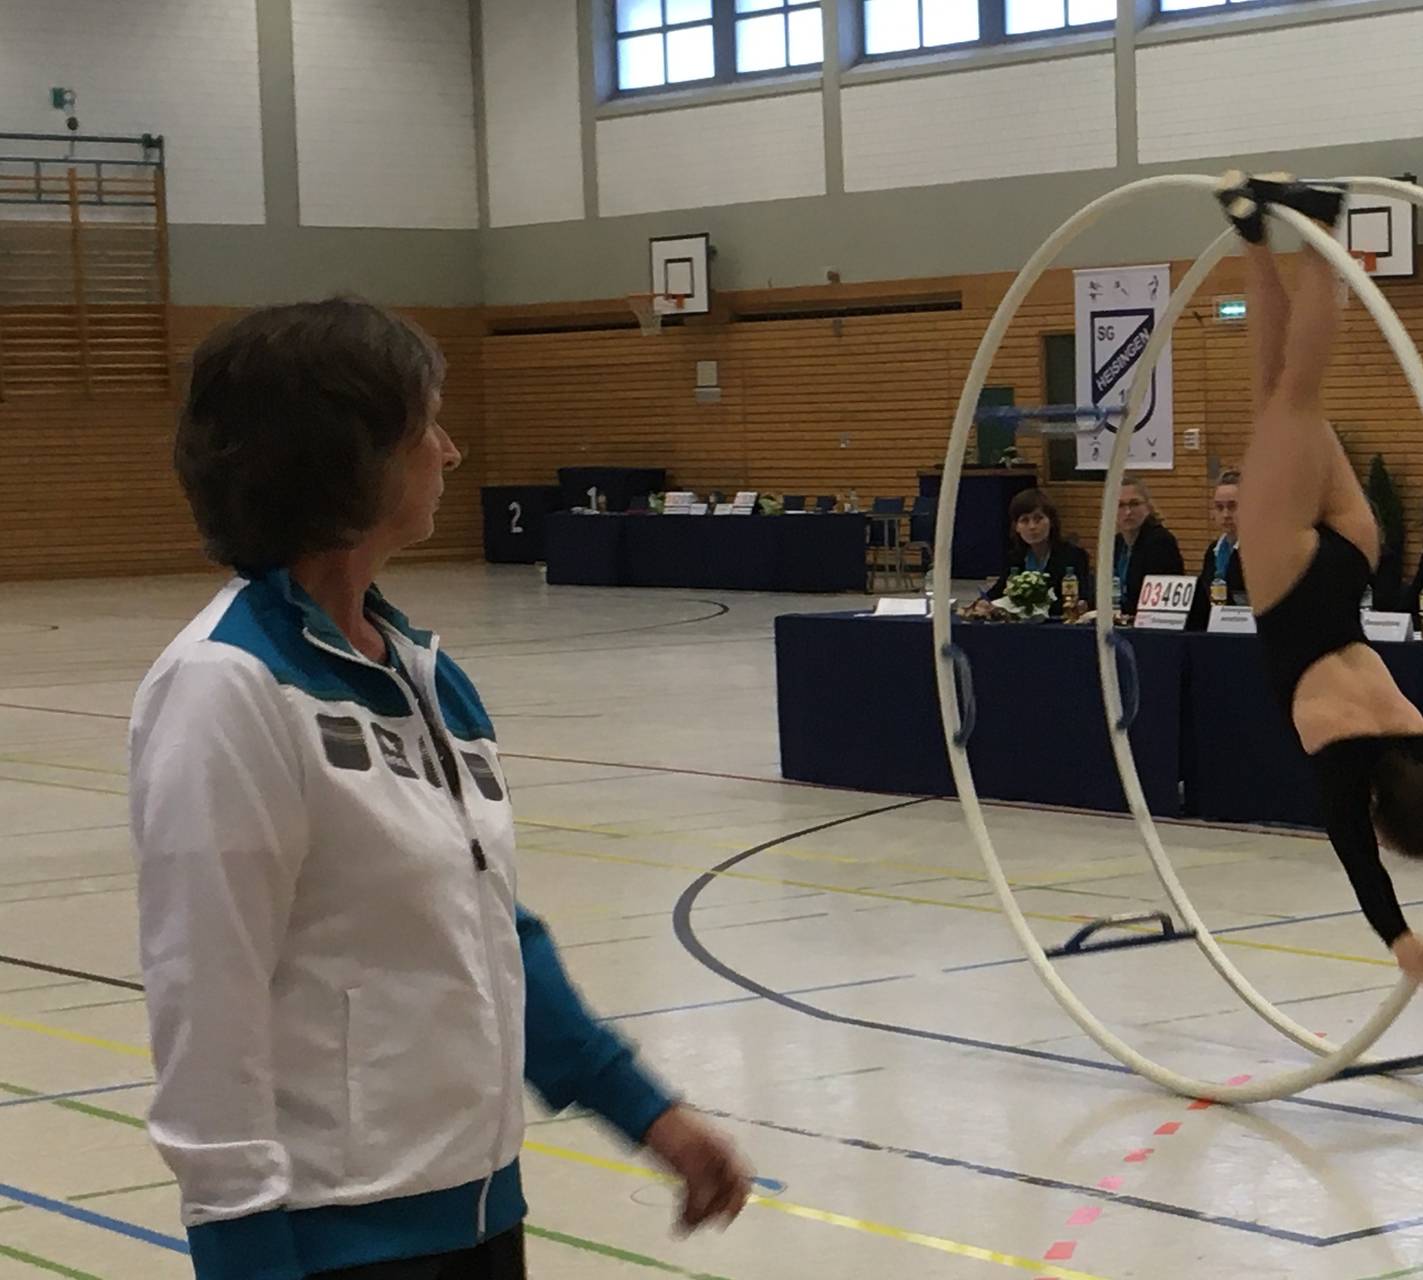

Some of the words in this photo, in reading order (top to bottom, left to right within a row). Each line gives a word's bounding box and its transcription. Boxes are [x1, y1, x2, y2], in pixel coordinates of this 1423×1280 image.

[1097, 325, 1115, 341] SG
[1096, 328, 1150, 392] HEISINGEN
[509, 502, 523, 533] 2
[1141, 581, 1193, 608] 03460
